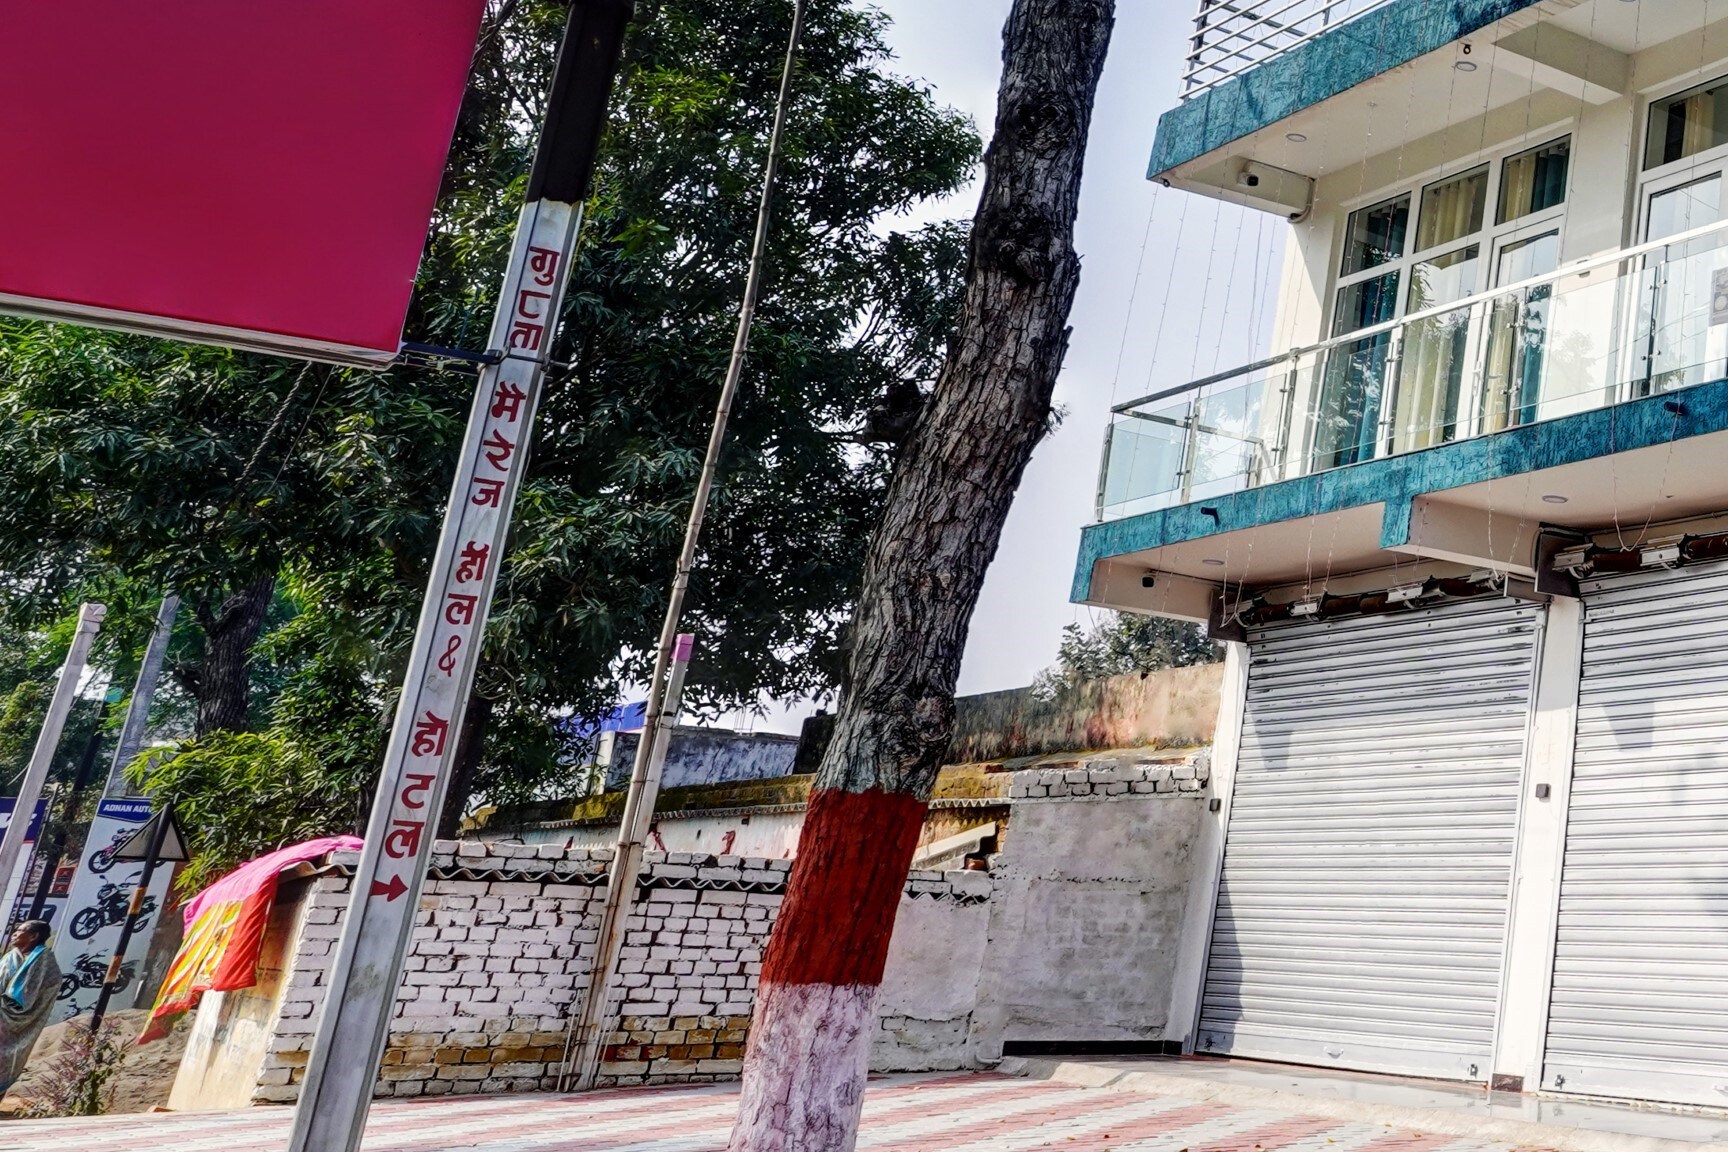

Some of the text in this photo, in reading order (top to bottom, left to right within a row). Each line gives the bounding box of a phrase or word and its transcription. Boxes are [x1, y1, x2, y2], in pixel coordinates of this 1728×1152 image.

[445, 540, 490, 625] हॉल
[103, 804, 132, 812] ADNAN
[385, 710, 449, 859] होटल
